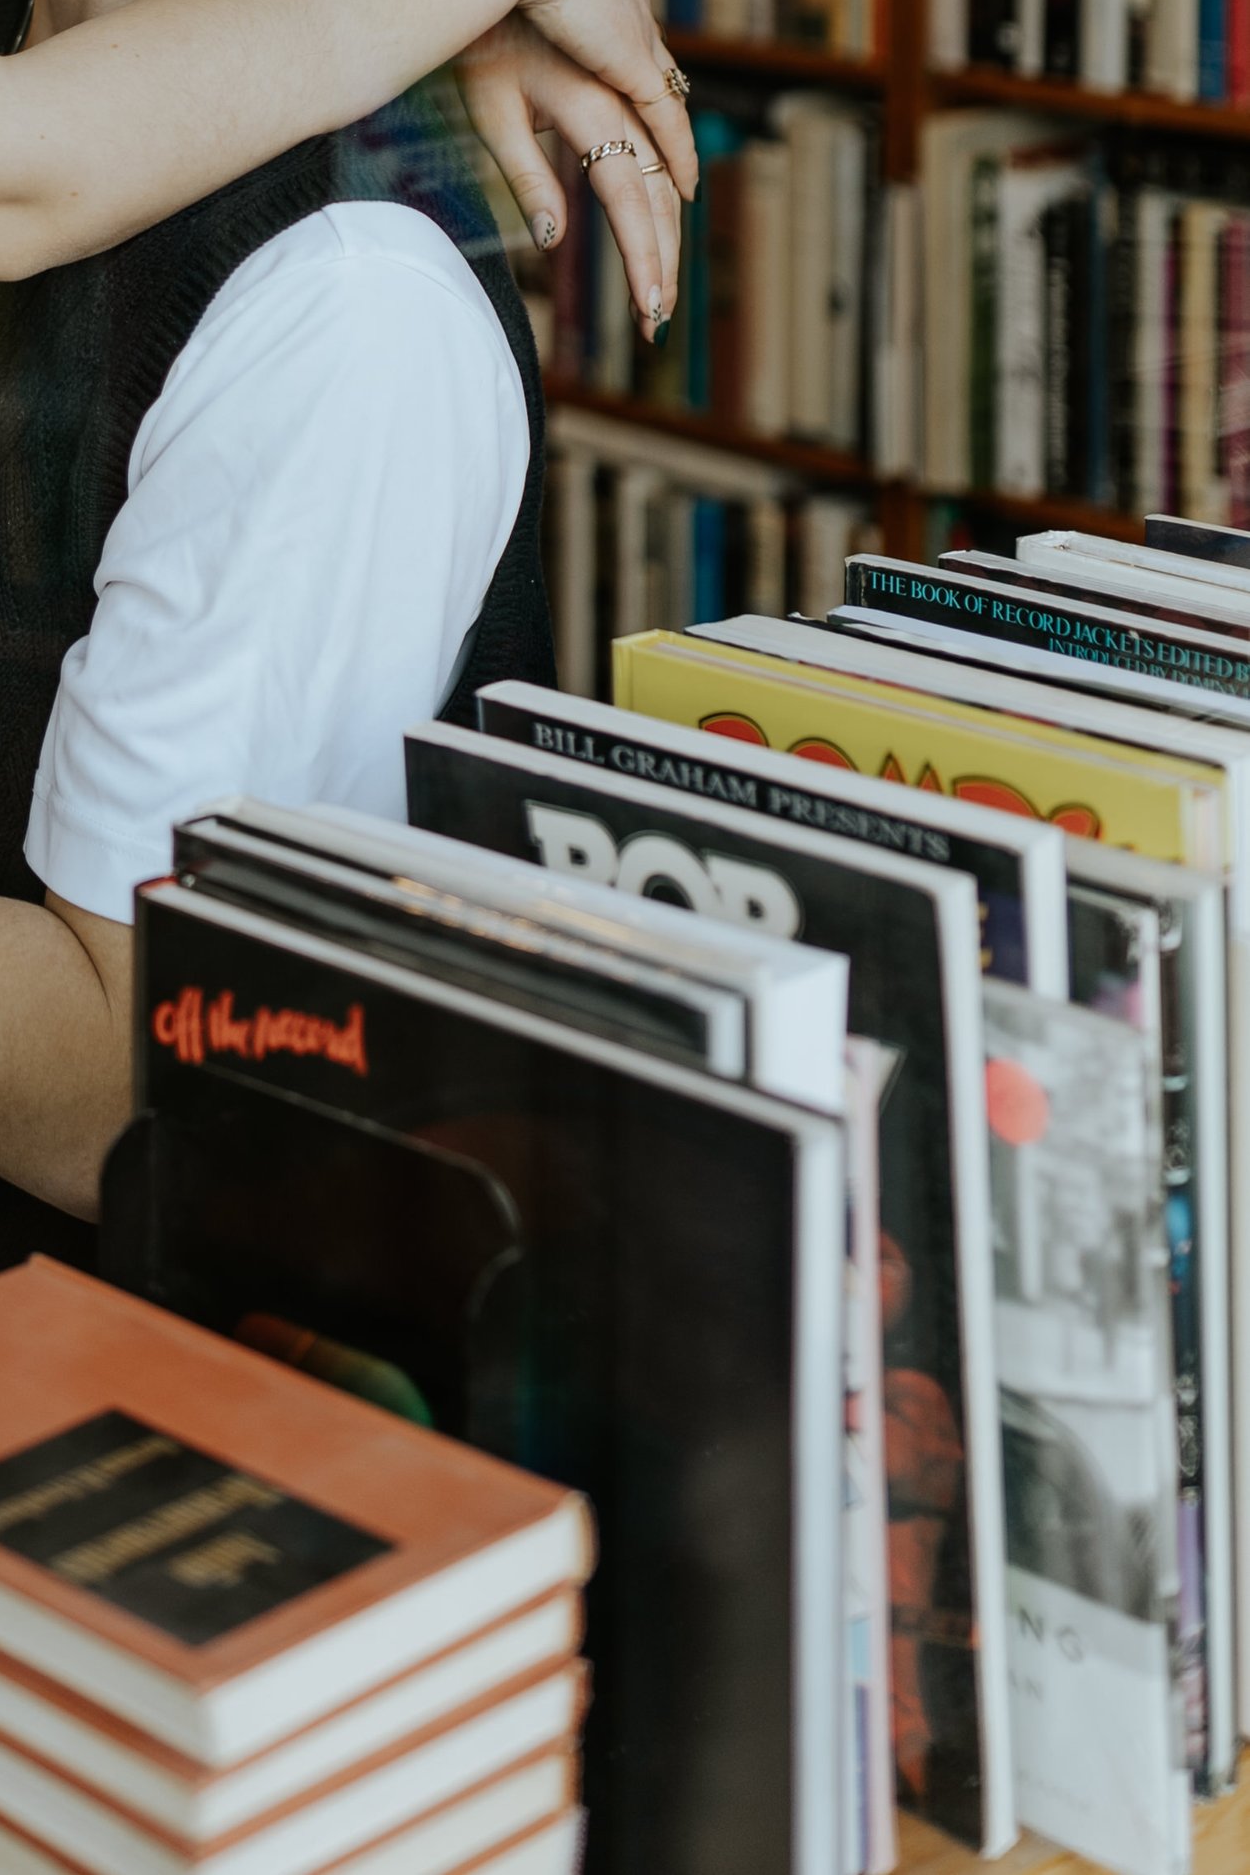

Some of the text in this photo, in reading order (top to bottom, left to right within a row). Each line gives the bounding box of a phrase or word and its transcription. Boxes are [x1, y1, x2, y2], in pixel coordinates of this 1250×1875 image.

[868, 570, 907, 597] THE
[911, 580, 961, 609] BOOK
[964, 593, 989, 615] OF
[992, 599, 1071, 637] RECORD
[1073, 620, 1155, 660] JACKETS
[1157, 642, 1234, 679] EDITED
[531, 721, 606, 766] BILL
[610, 743, 758, 806] GRAHAM
[766, 785, 951, 863] PRESENTS
